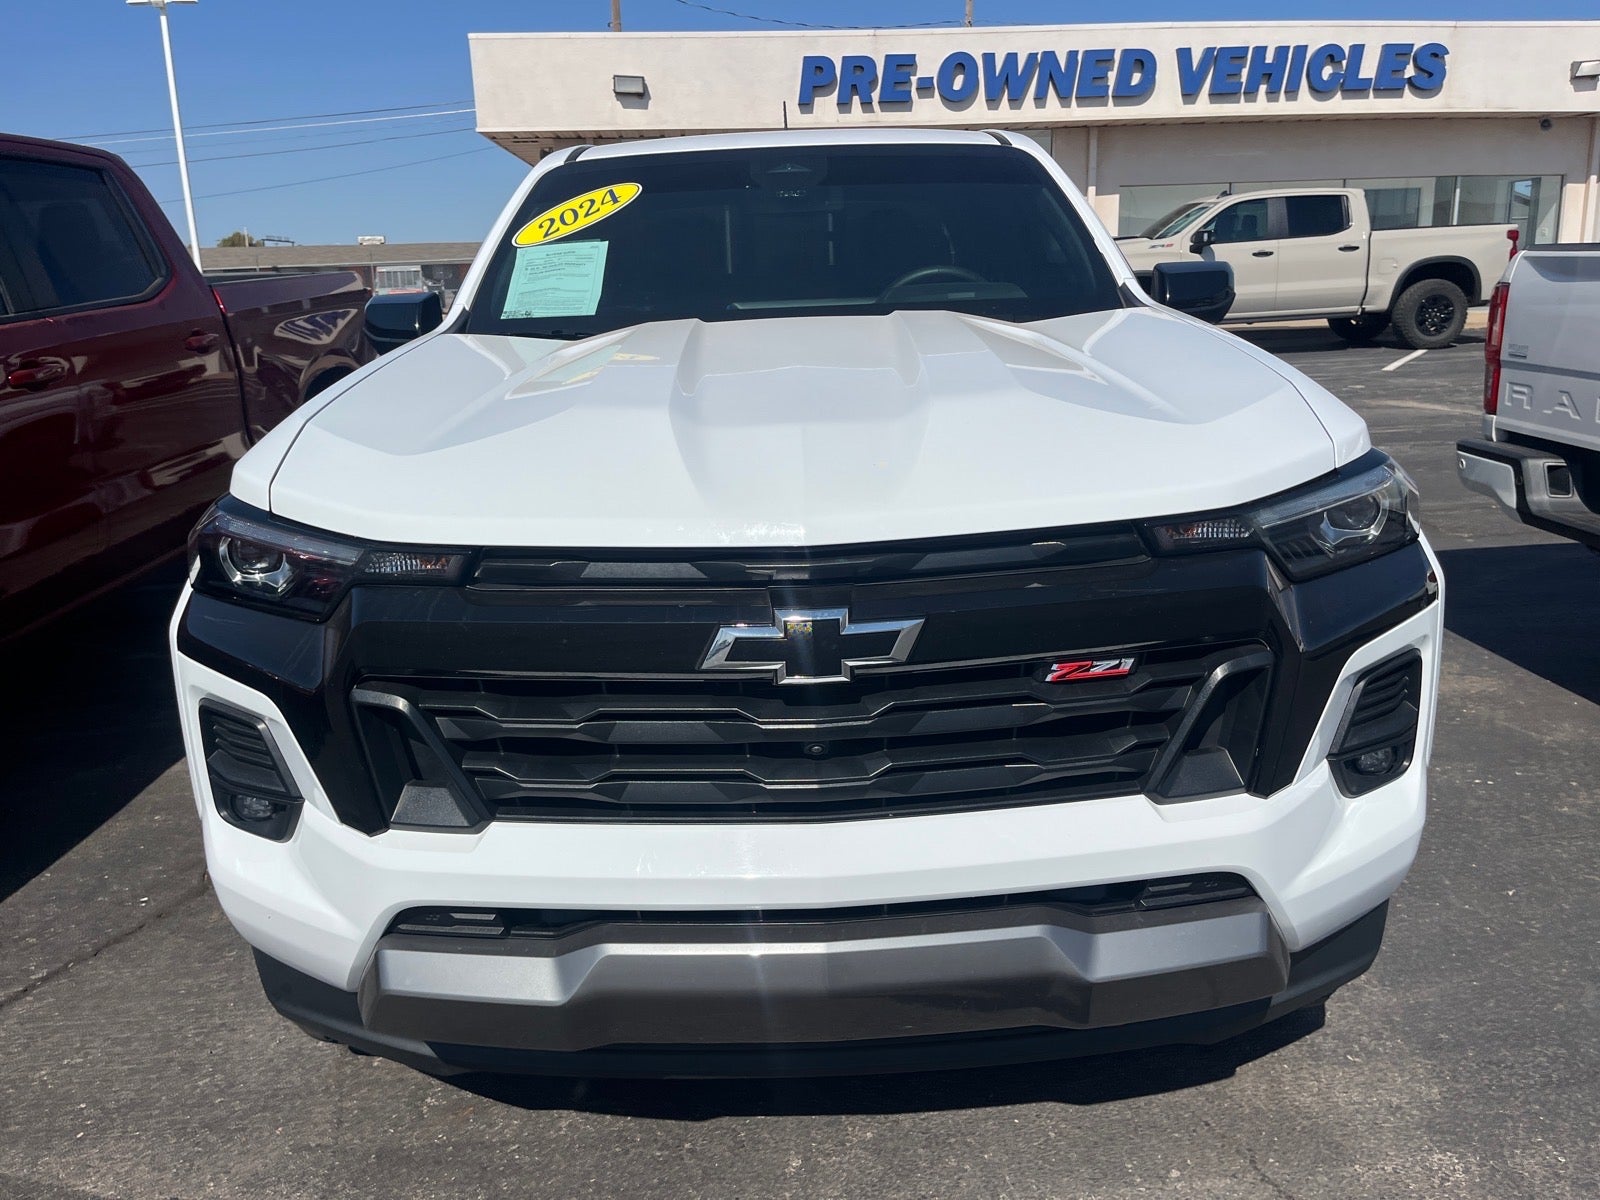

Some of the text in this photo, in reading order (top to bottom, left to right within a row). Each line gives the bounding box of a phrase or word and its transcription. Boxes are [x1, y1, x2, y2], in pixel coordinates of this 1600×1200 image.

[798, 43, 1450, 106] PRE-OWNED VEHICLES
[538, 188, 622, 239] 2024
[1504, 381, 1600, 424] RA
[1044, 658, 1135, 682] Z71
